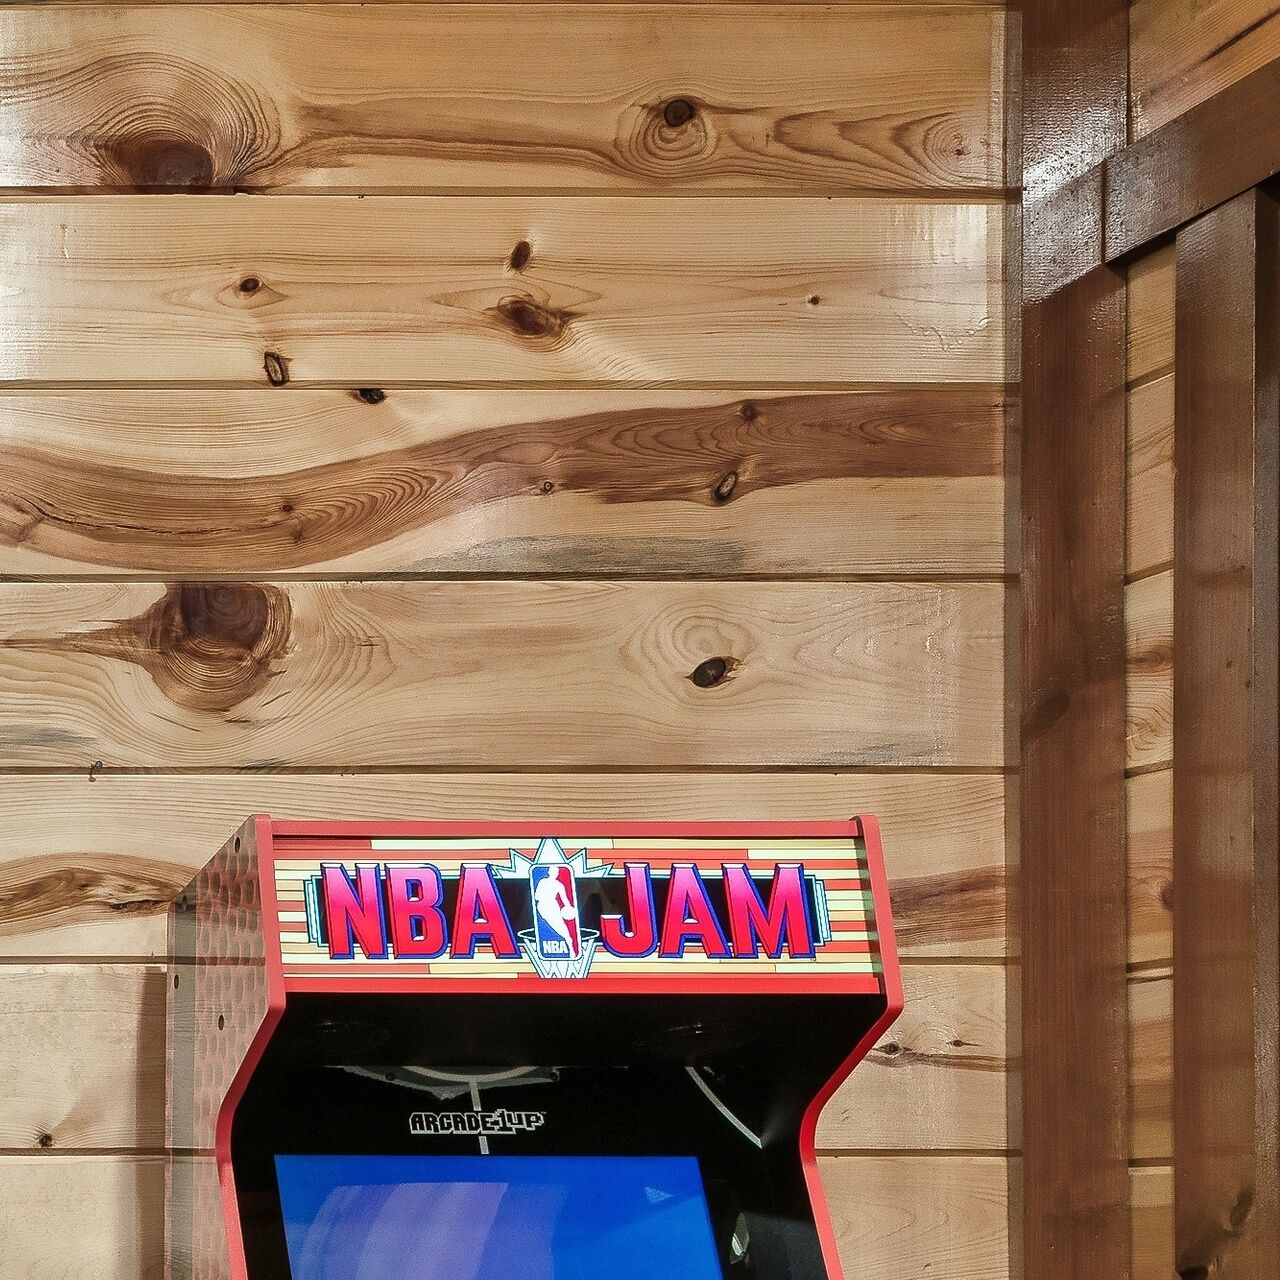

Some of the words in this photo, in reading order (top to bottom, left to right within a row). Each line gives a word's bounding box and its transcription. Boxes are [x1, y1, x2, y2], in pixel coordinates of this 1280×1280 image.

[321, 862, 524, 960] NBA
[601, 862, 820, 960] JAM
[542, 940, 569, 954] NBA
